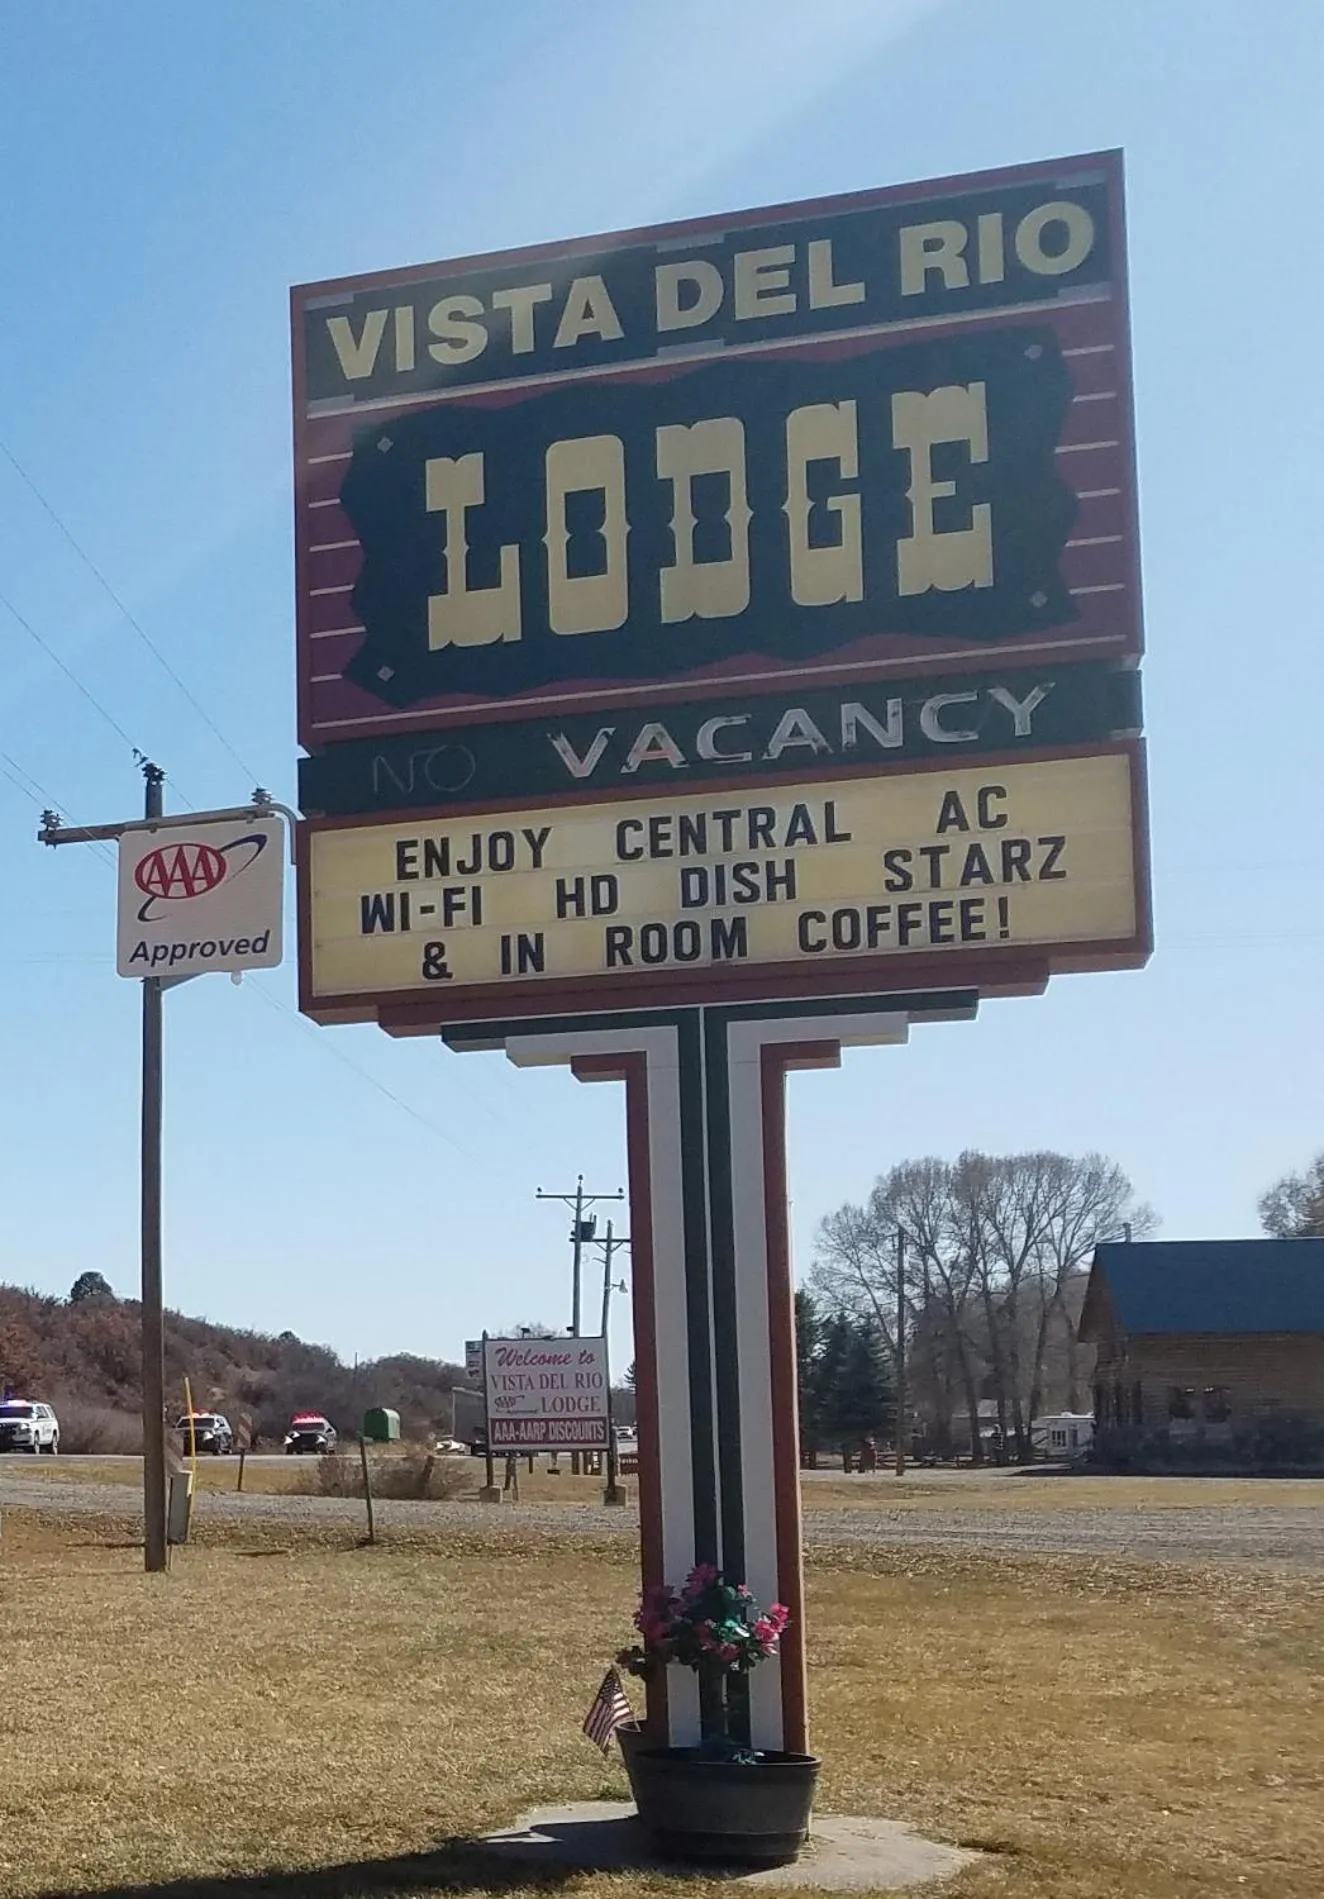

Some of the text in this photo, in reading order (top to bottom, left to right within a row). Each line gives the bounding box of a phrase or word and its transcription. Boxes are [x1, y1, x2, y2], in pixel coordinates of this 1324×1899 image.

[326, 201, 1095, 380] VISTA DEL RIO
[425, 382, 993, 651] LODGE
[372, 682, 1055, 794] NO VACANCY
[396, 786, 1008, 881] ENJOY CENTRAL AC
[145, 845, 216, 898] AAA
[361, 837, 1066, 935] WI-FI HD DISH STARZ
[129, 930, 270, 967] Approved
[423, 897, 1010, 979] & IN ROOM COFFEE!
[490, 1372, 603, 1391] VISTA DEL RIO
[496, 1347, 595, 1367] Welcome to
[494, 1421, 604, 1441] AAA-AARP DISCOUNTS
[542, 1396, 601, 1412] LODGE
